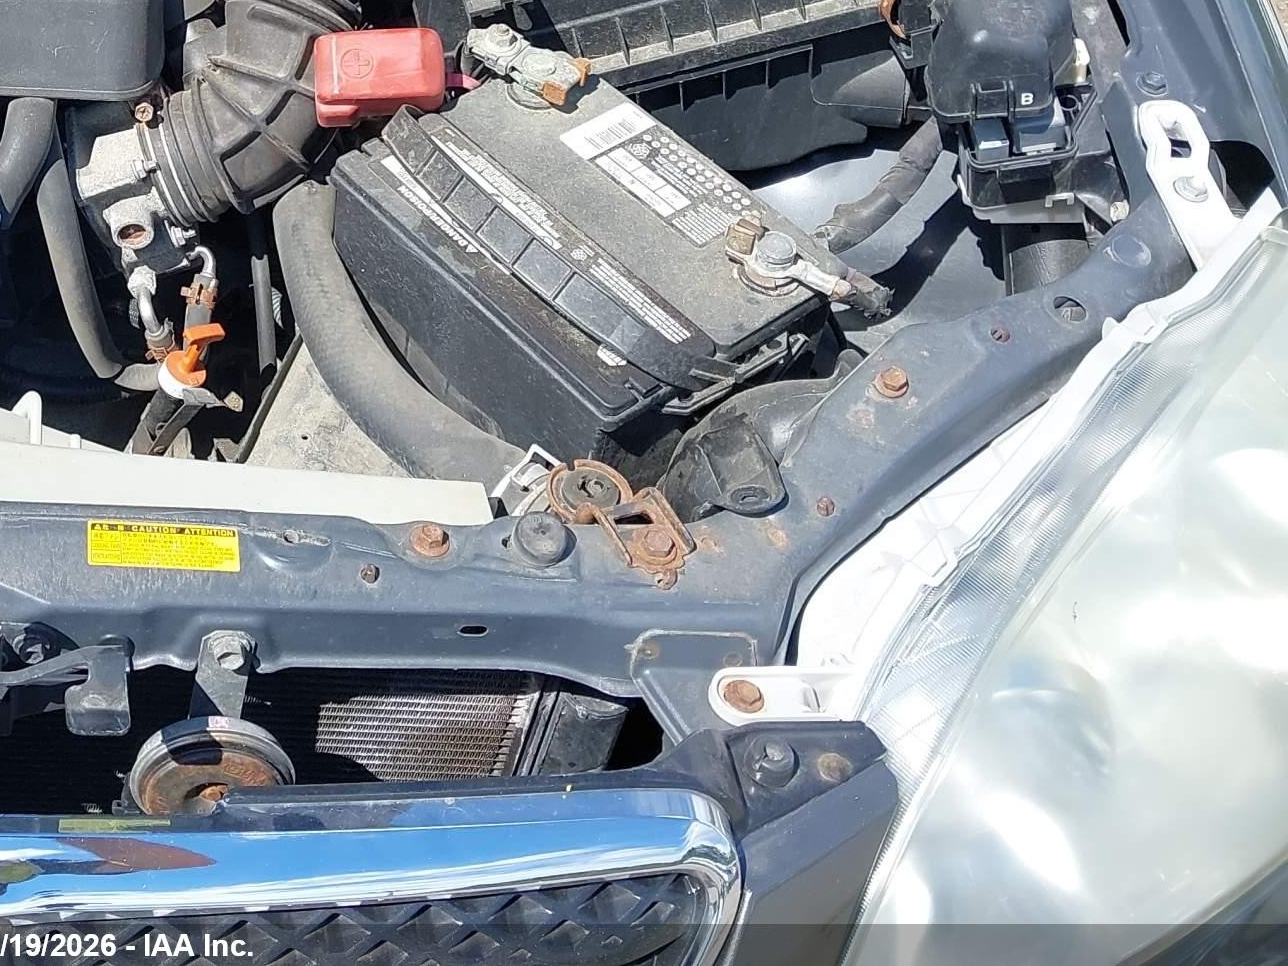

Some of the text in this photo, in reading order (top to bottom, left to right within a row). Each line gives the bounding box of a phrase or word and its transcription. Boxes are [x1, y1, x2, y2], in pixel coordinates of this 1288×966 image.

[1020, 92, 1034, 106] B
[397, 185, 469, 247] DANGER/POISON
[132, 524, 177, 535] CAUTION
[184, 528, 234, 537] ATTENTION
